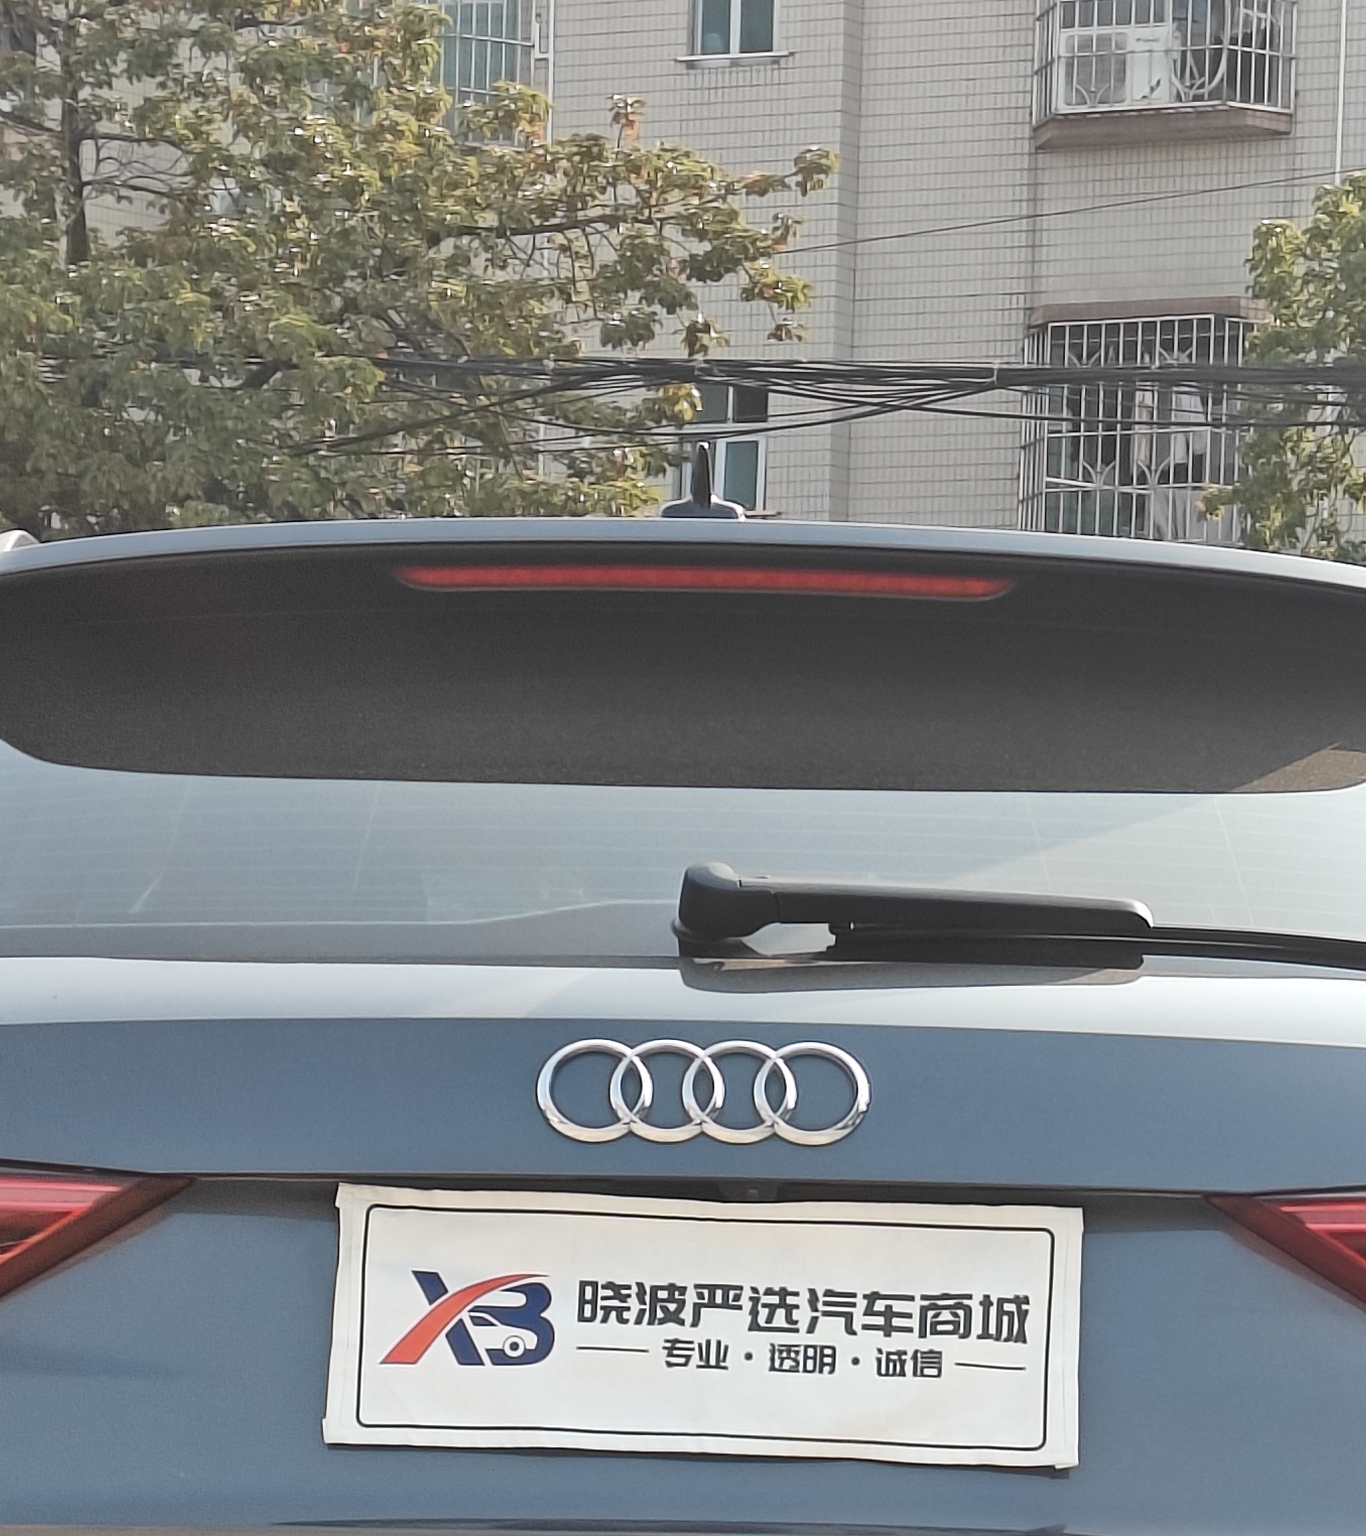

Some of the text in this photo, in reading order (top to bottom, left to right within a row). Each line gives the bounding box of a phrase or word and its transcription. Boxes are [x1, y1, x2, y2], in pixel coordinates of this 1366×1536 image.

[576, 1279, 1031, 1345] 晓波严选汽车商城
